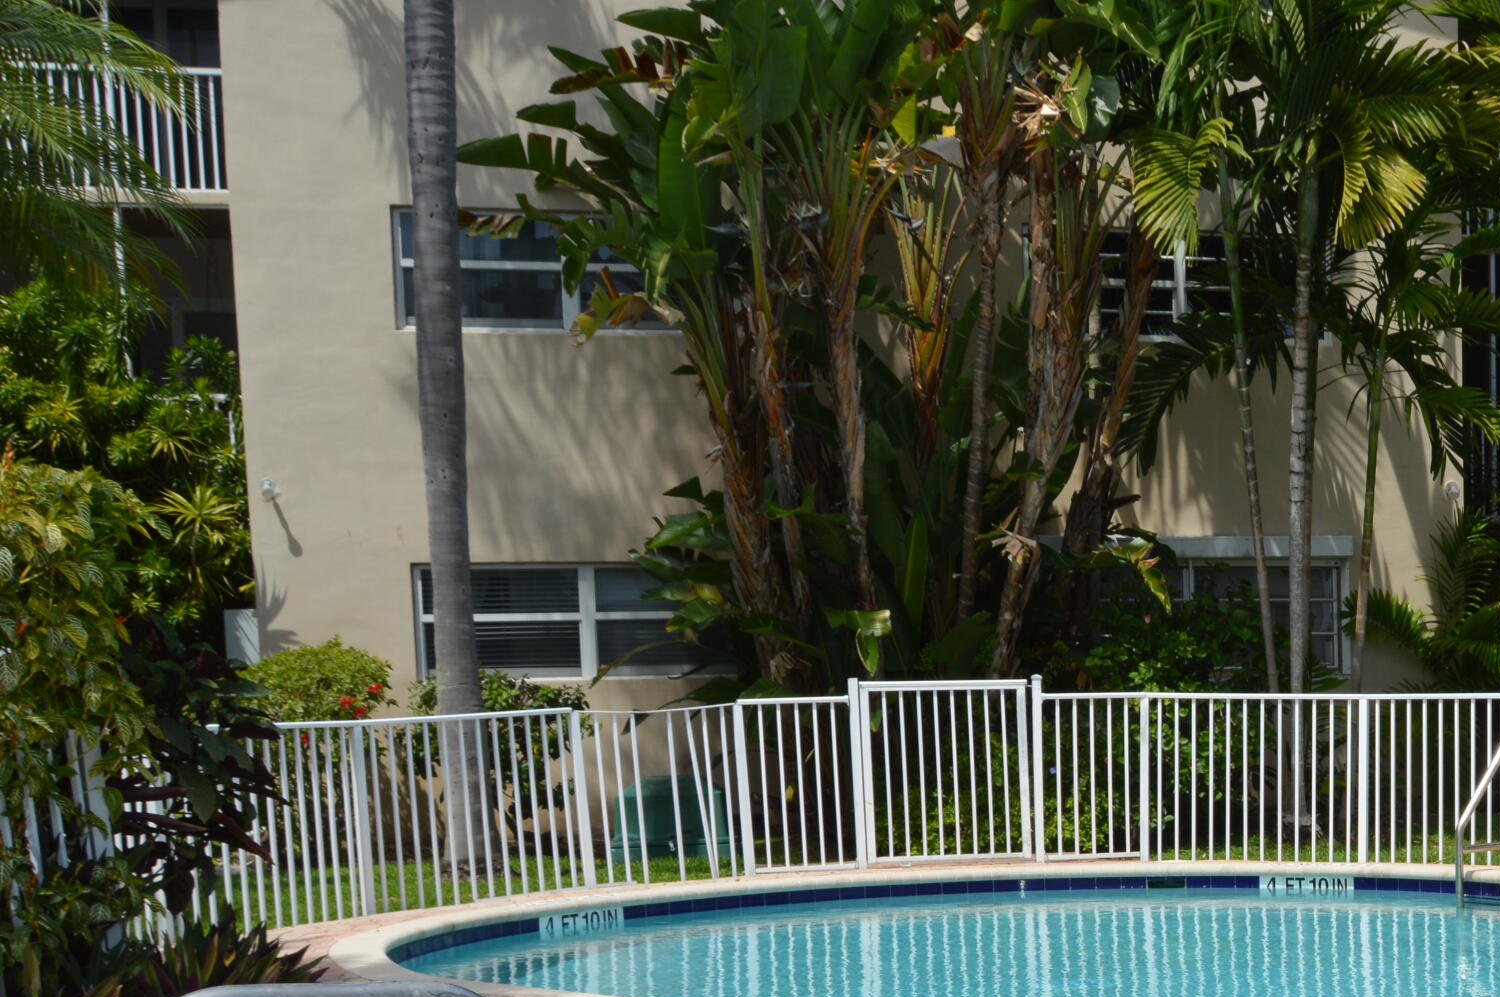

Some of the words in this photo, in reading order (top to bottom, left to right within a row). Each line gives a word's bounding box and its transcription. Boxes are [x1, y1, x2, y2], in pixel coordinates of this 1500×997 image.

[1285, 877, 1306, 889] FT
[1308, 878, 1329, 889] 10
[1332, 878, 1348, 889] IN
[561, 913, 579, 927] FT
[581, 911, 600, 924] 10
[602, 908, 618, 922] IN
